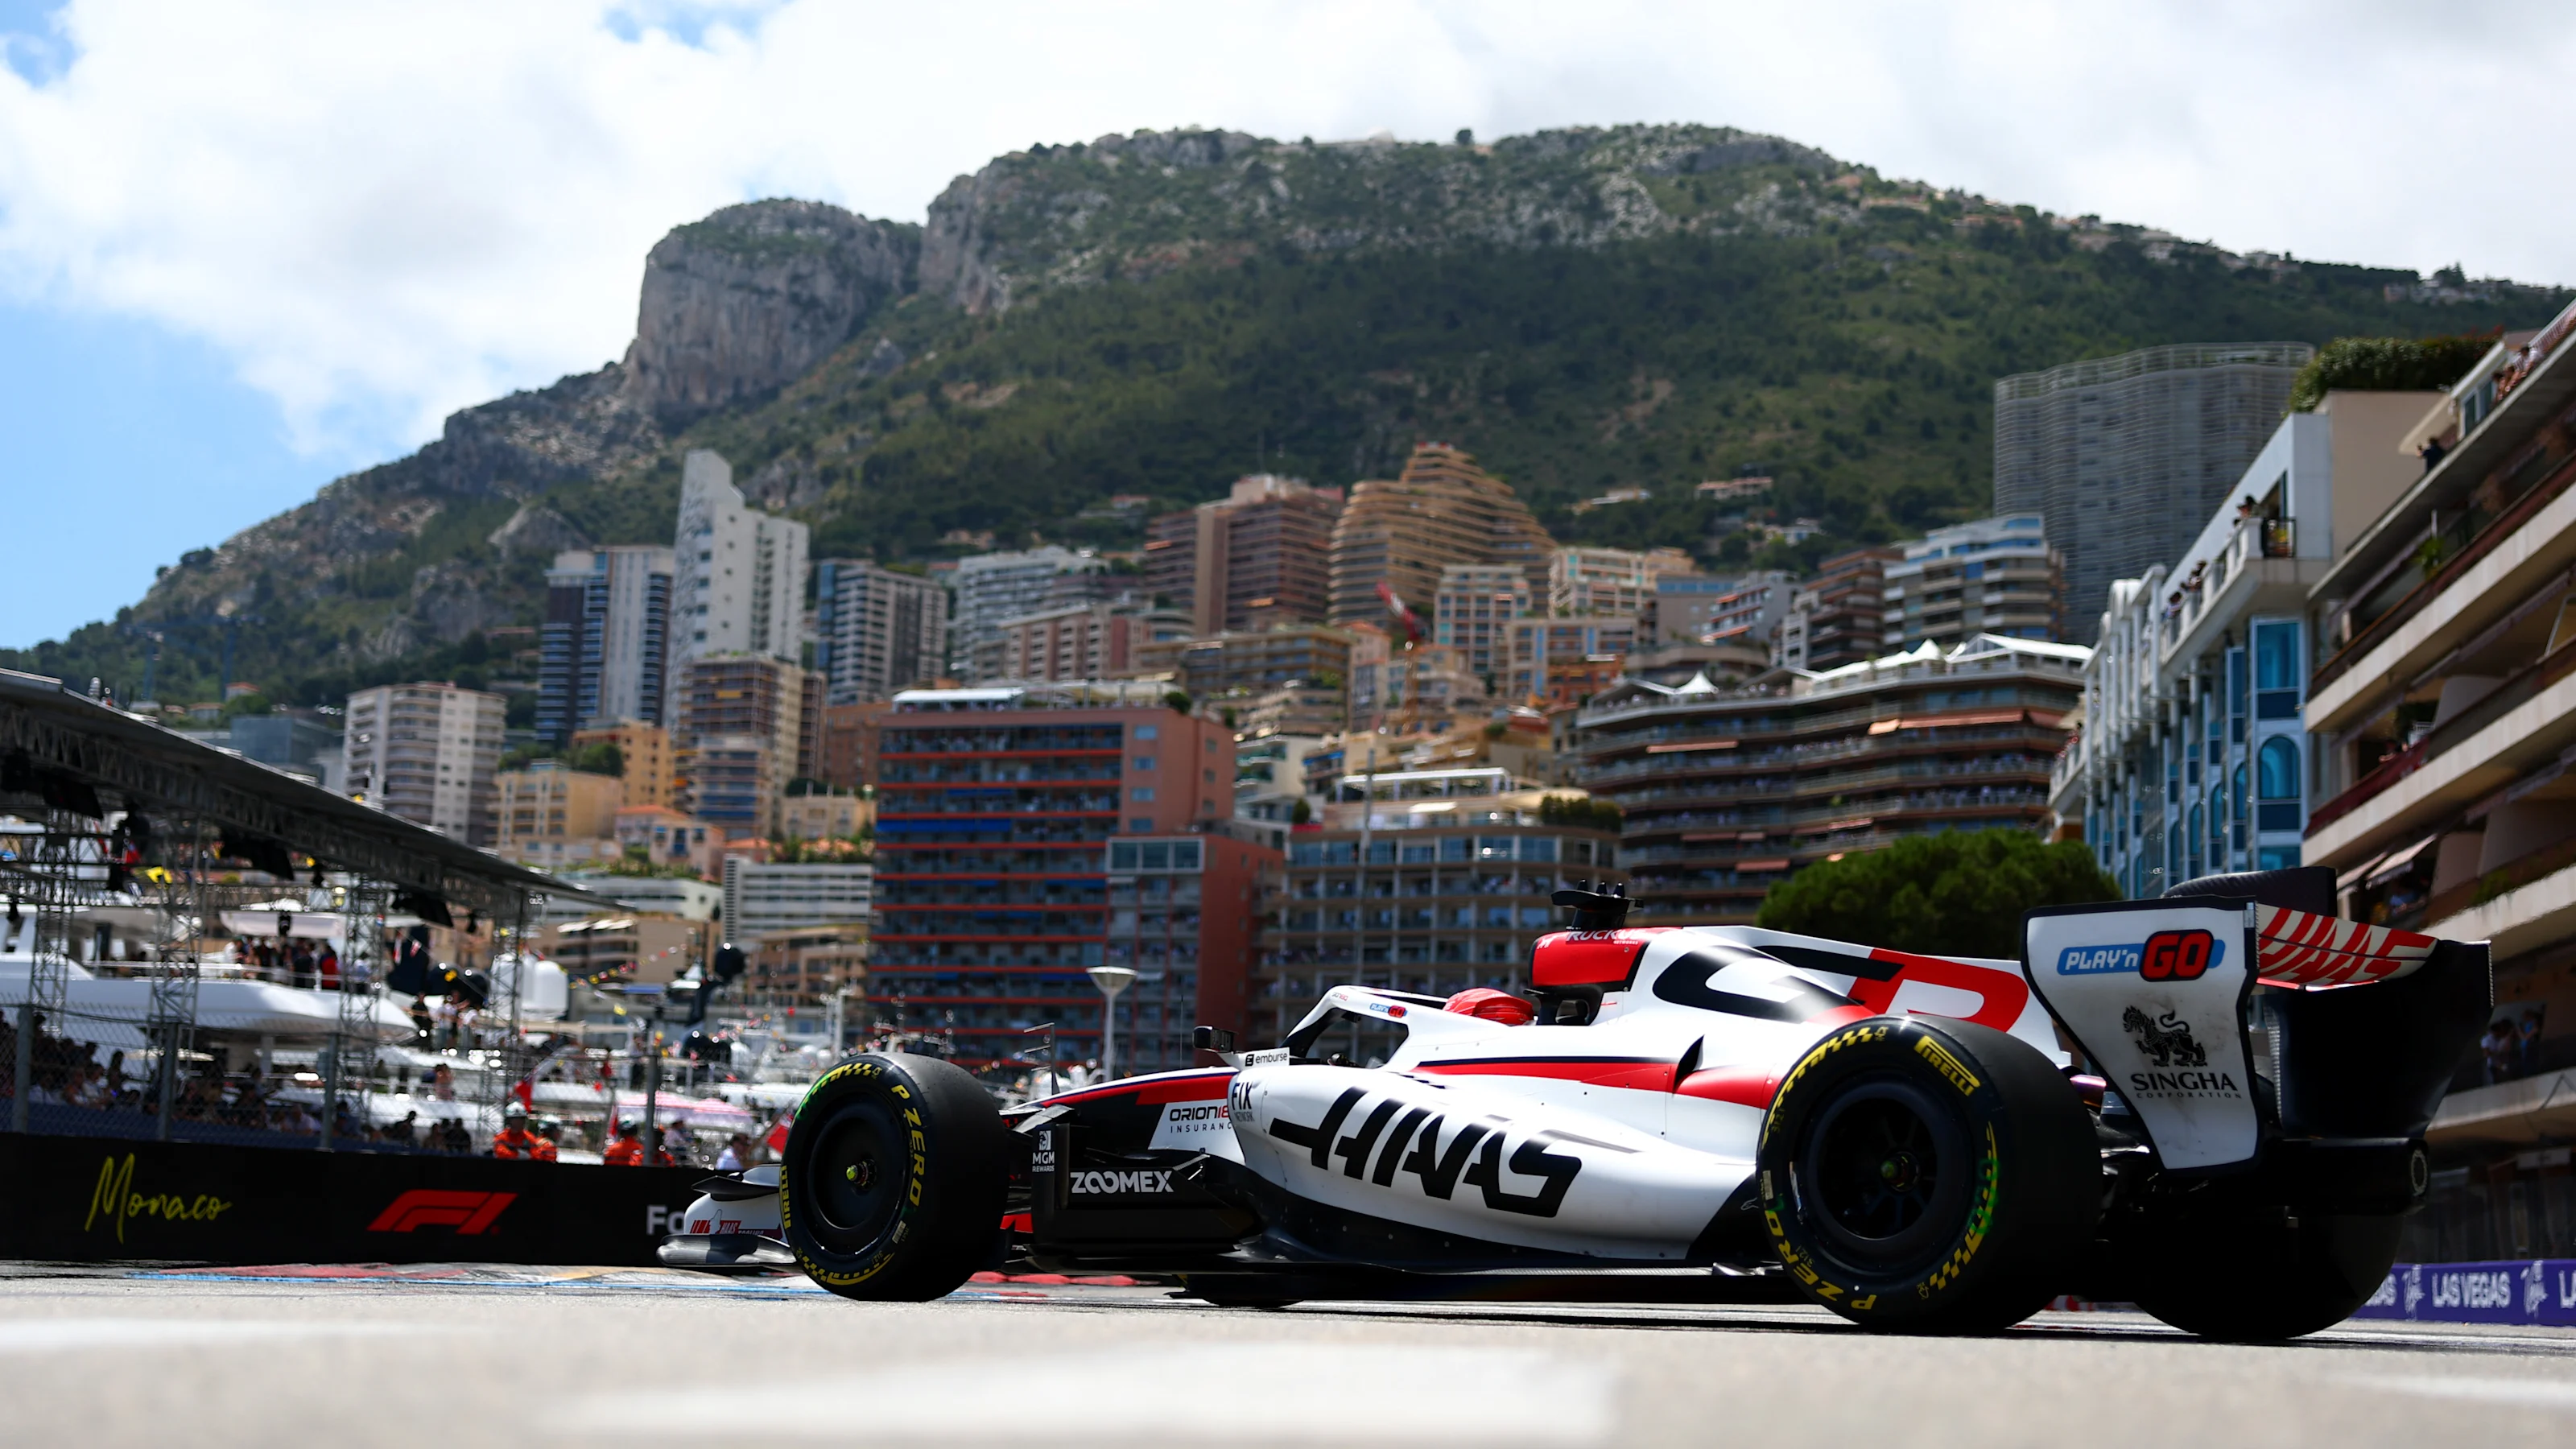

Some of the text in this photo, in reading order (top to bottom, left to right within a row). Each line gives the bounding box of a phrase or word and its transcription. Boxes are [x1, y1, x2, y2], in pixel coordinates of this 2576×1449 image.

[2141, 932, 2211, 979] GO
[1389, 1005, 1406, 1018] GO
[1255, 1052, 1287, 1064] emburse
[1914, 1035, 1980, 1096] PIRELLI
[1232, 1081, 1253, 1111] FIX
[2130, 1072, 2238, 1092] SINGHA
[891, 1084, 910, 1100] P
[905, 1108, 926, 1207] ZERO
[1032, 1151, 1055, 1165] MGM
[1269, 1086, 1644, 1219] HAAS
[85, 1152, 232, 1245] Monaco
[1070, 1170, 1174, 1194] ZOOMEX
[366, 1189, 518, 1235] F1
[1765, 1210, 1876, 1310] P ZERO
[2432, 1272, 2460, 1308] LAS
[2460, 1271, 2511, 1309] VEGAS
